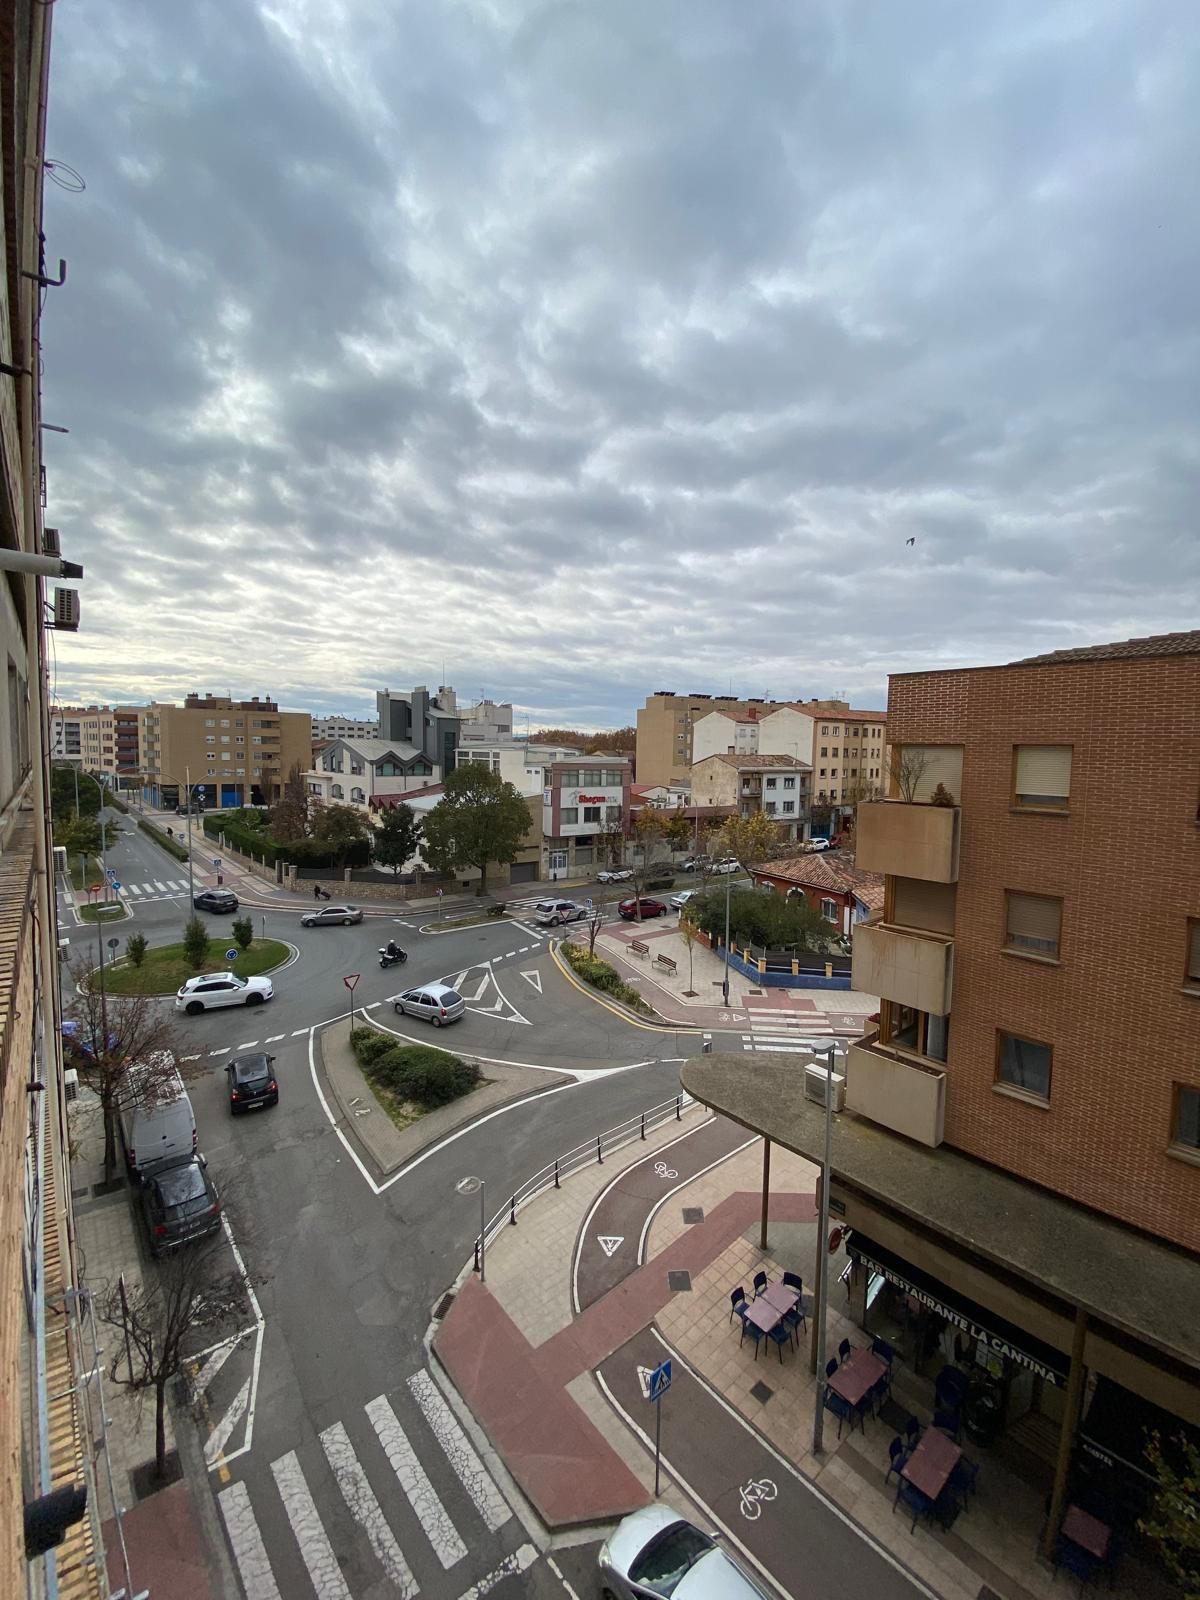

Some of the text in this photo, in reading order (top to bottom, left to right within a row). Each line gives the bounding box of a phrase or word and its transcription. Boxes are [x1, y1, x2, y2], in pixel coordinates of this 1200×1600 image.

[860, 1255, 1056, 1384] BAR RESTAURANTE LA CANTINA
